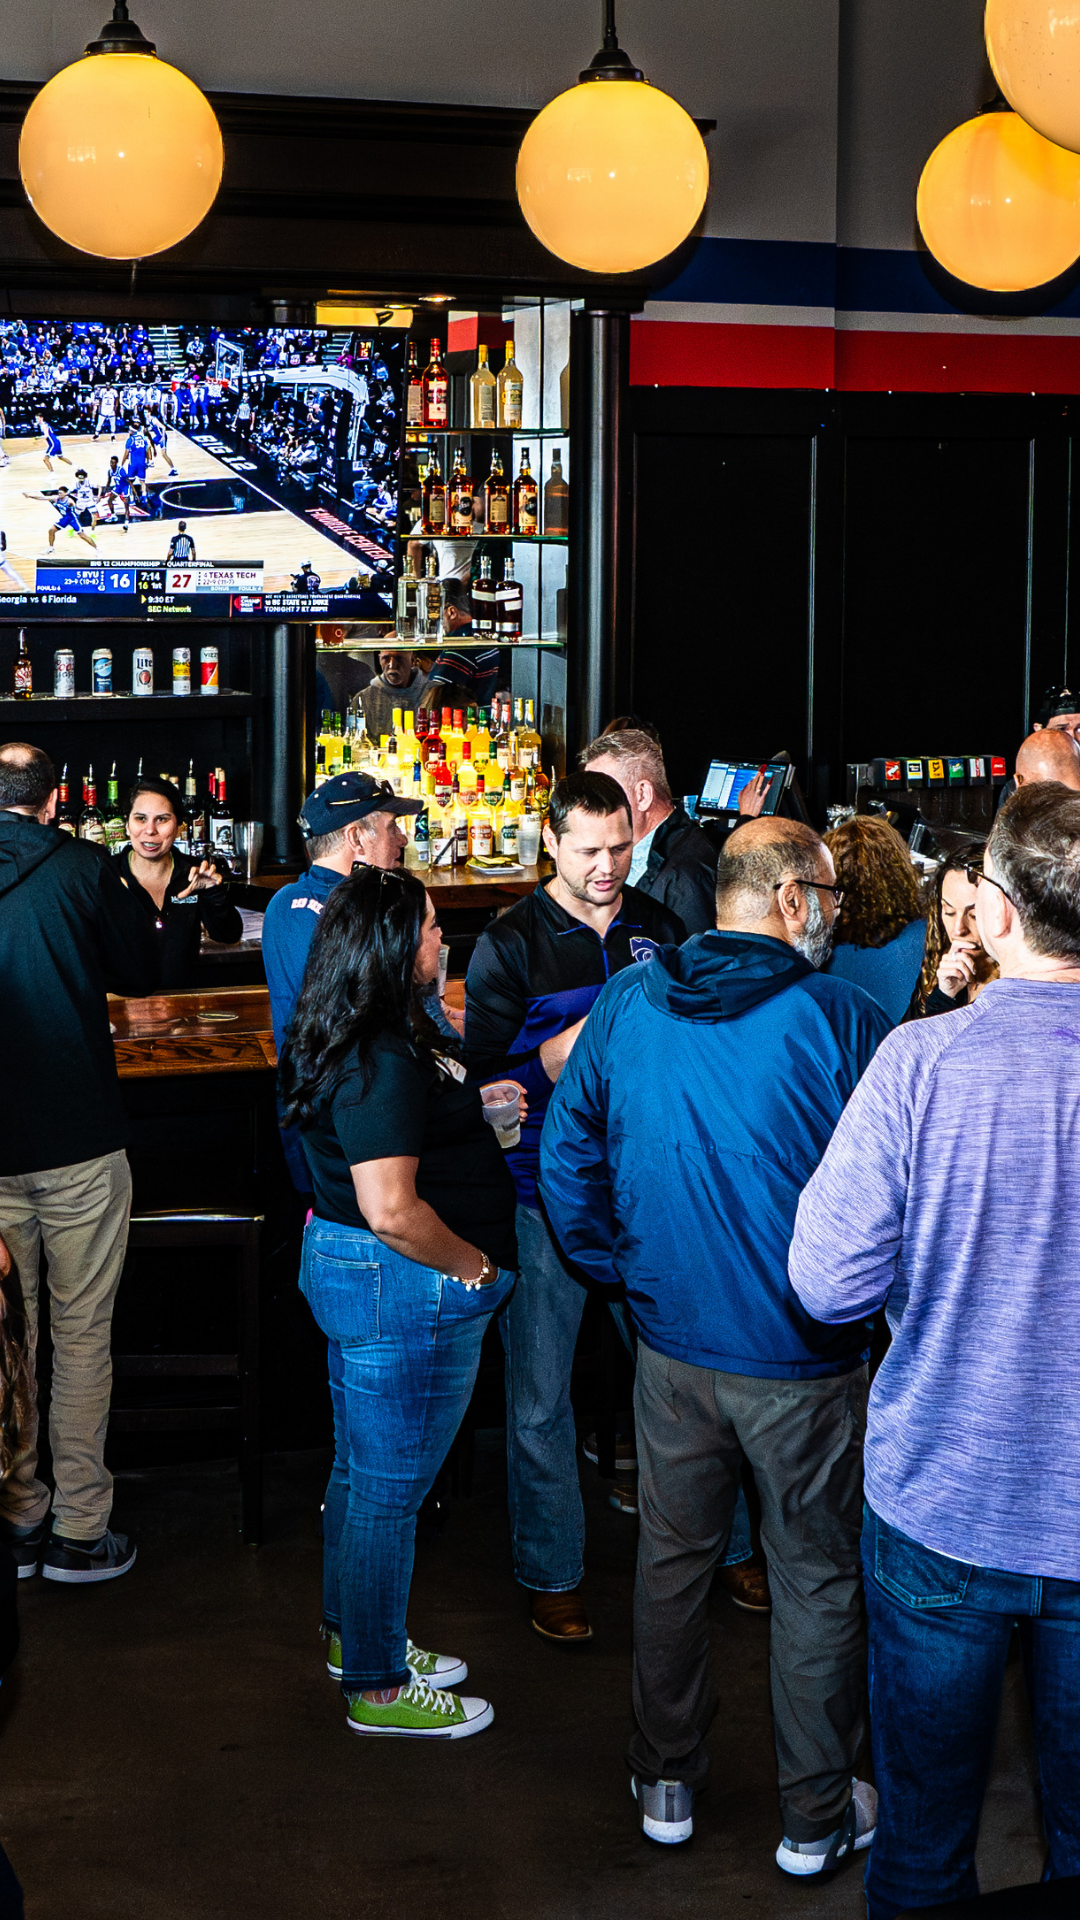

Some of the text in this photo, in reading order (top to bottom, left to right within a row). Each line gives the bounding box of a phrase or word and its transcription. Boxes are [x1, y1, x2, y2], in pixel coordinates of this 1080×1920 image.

[192, 434, 258, 471] BIG 12
[110, 573, 130, 588] 16
[141, 572, 160, 581] 7:14
[172, 574, 191, 588] 27
[0, 595, 28, 605] eorgia
[48, 595, 77, 603] Florida
[147, 605, 191, 613] SEC Network
[136, 658, 153, 669] Lite
